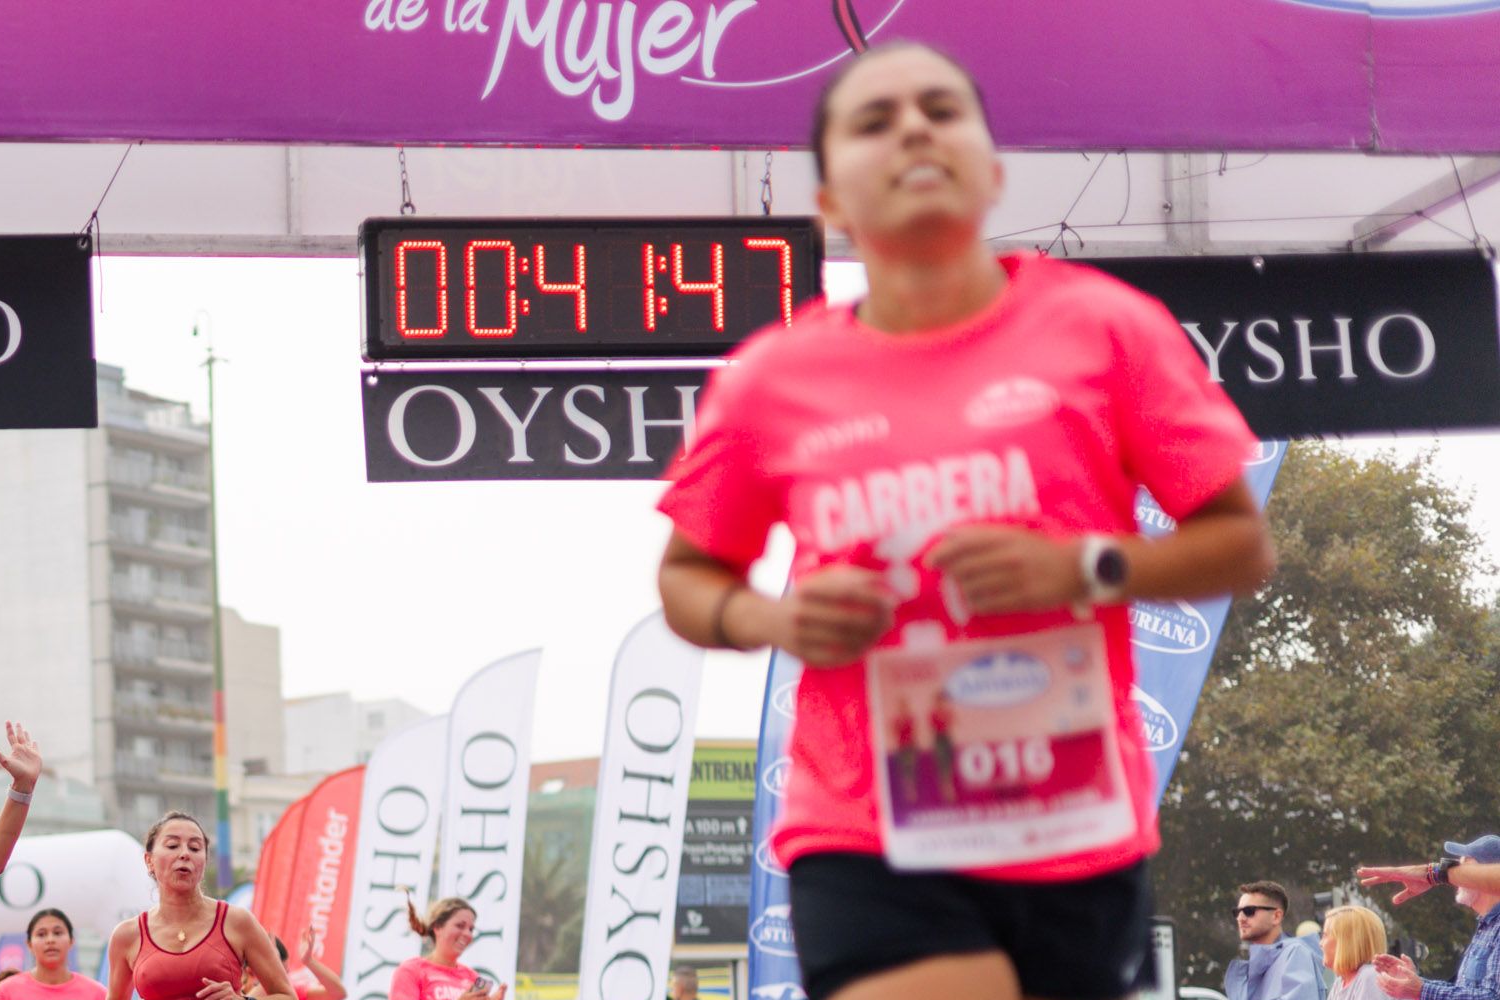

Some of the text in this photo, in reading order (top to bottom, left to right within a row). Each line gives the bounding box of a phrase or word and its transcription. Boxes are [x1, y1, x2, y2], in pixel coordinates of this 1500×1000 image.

[481, 0, 757, 121] Mujer
[1182, 313, 1436, 384] YSHO
[387, 384, 700, 467] OYSH
[813, 445, 1042, 551] CARRERA
[957, 738, 1055, 788] 016
[453, 731, 517, 985] SHO
[695, 819, 719, 833] 100
[310, 807, 350, 957] Santander
